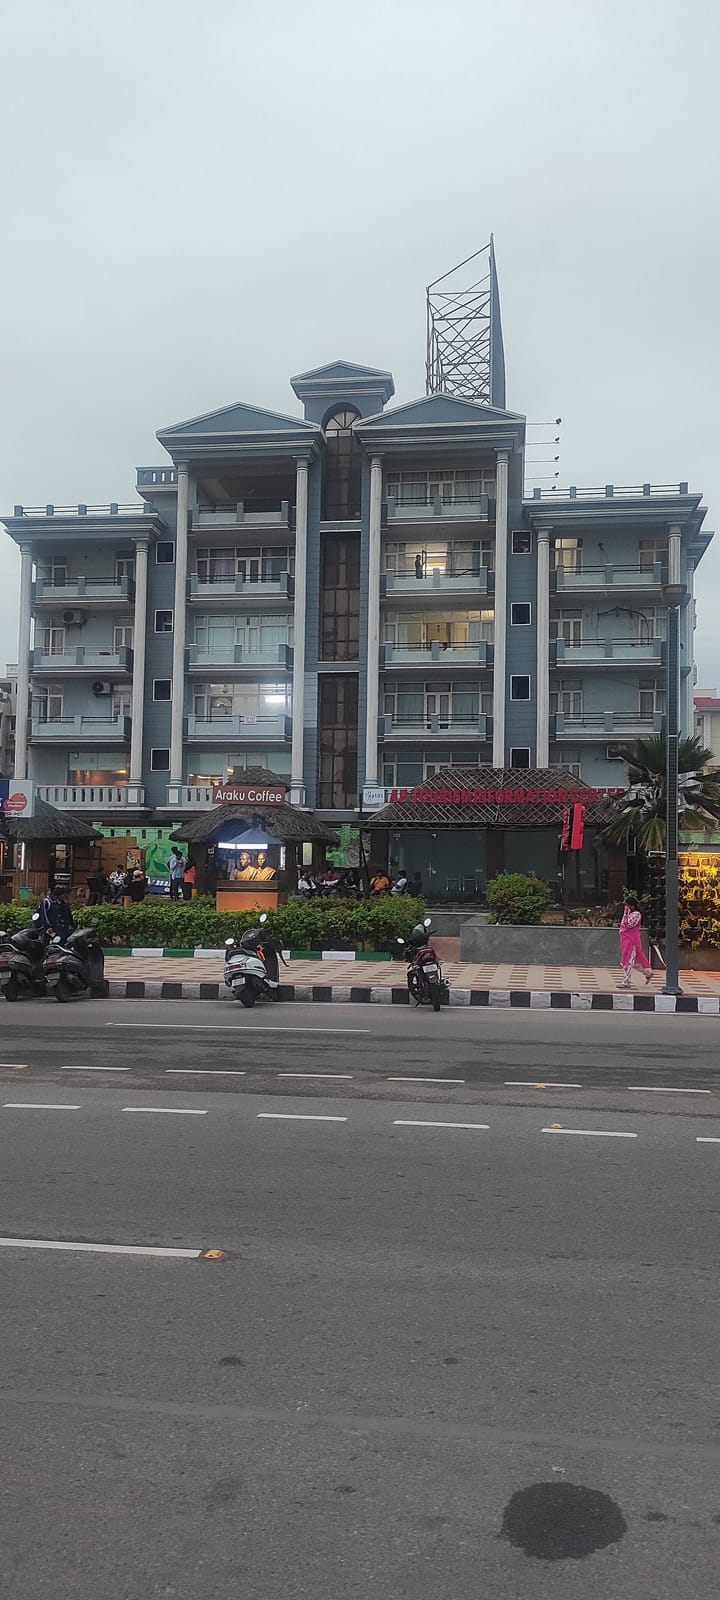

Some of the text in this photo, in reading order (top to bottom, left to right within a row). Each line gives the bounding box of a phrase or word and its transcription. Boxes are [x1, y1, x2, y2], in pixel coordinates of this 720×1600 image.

[215, 789, 282, 802] Araku Coffee
[390, 789, 409, 803] AP
[412, 787, 473, 804] TOURISM
[474, 787, 567, 804] INFORMATION
